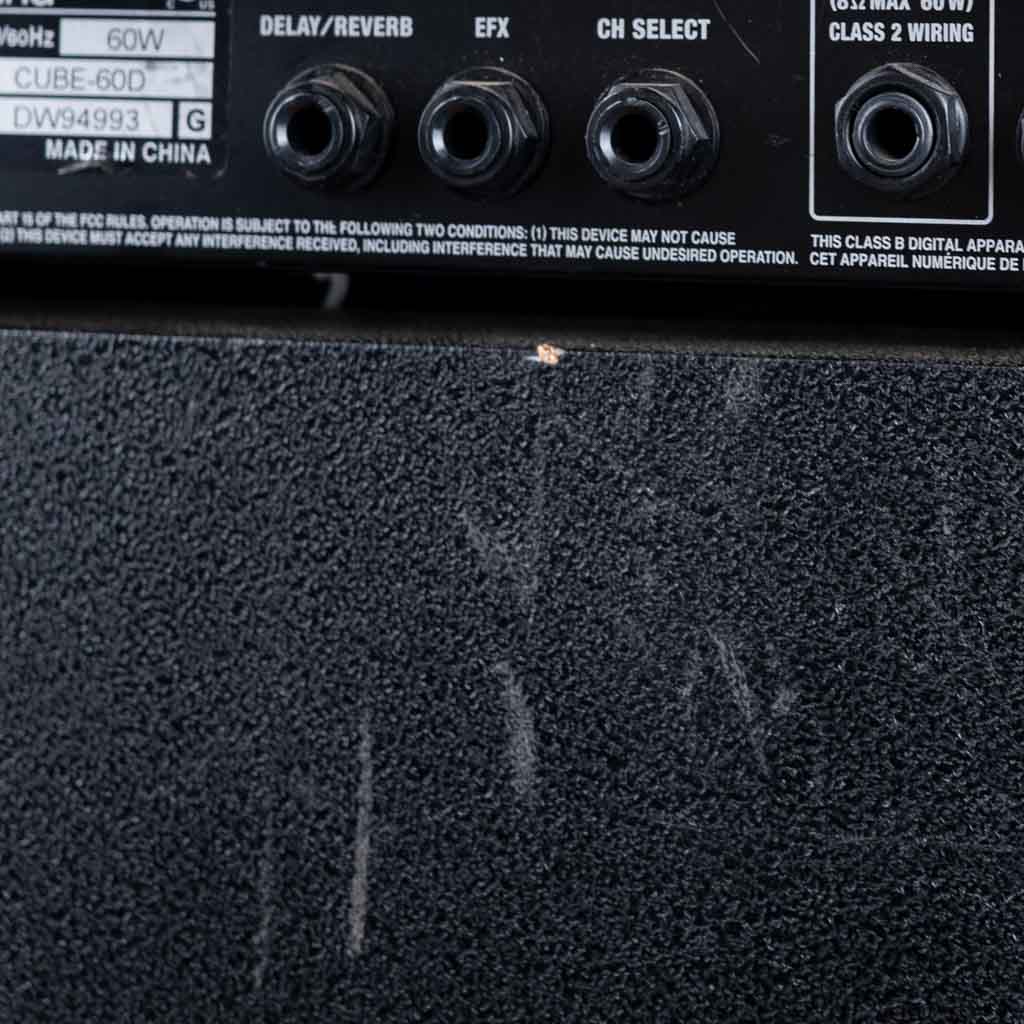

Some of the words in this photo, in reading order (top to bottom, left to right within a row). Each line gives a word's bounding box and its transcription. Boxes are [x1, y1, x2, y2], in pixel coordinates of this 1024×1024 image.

[259, 15, 413, 37] DELAY/REVERB
[474, 17, 510, 38] EFX
[597, 17, 625, 39] CH
[632, 17, 711, 40] SELECT
[829, 21, 886, 42] CLASS
[890, 22, 903, 42] 2
[907, 22, 975, 43] WIRING
[107, 27, 164, 51] 60W
[14, 65, 146, 92] CUBE-60D
[14, 106, 139, 132] DW94993
[187, 109, 205, 132] G
[45, 138, 107, 161] MADE
[113, 140, 136, 162] IN
[142, 141, 212, 164] CHINA
[151, 215, 219, 231] OPERATION
[221, 217, 233, 231] IS
[236, 217, 290, 233] SUBJECT
[294, 219, 310, 234] TO
[314, 219, 337, 234] THE
[340, 220, 412, 236] FOLLOWING
[416, 222, 445, 237] TWO
[447, 223, 528, 240] CONDITIONS:
[531, 225, 547, 242] (1)
[550, 226, 578, 241] THIS
[581, 227, 627, 243] DEVICE
[631, 228, 658, 244] MAY
[661, 229, 689, 244] NOT
[691, 230, 736, 246] CAUSE
[174, 233, 201, 248] ANY
[202, 234, 294, 250] INTERFERENCE
[296, 236, 360, 254] RECEIVED,
[362, 238, 429, 254] INCLUDING
[432, 240, 527, 257] INTERFERENCE
[531, 243, 562, 258] THAT
[565, 244, 592, 259] MAY
[595, 245, 639, 260] CAUSE
[642, 246, 717, 263] UNDESIRED
[719, 249, 799, 265] OPERATION.
[811, 234, 841, 248] THIS
[845, 235, 891, 249] CLASS
[894, 236, 905, 250] B
[908, 237, 963, 251] DIGITAL
[809, 252, 837, 266] CET
[840, 253, 909, 268] APPAREIL
[912, 252, 996, 271] NUMÉRIQUE
[999, 257, 1018, 271] DE
